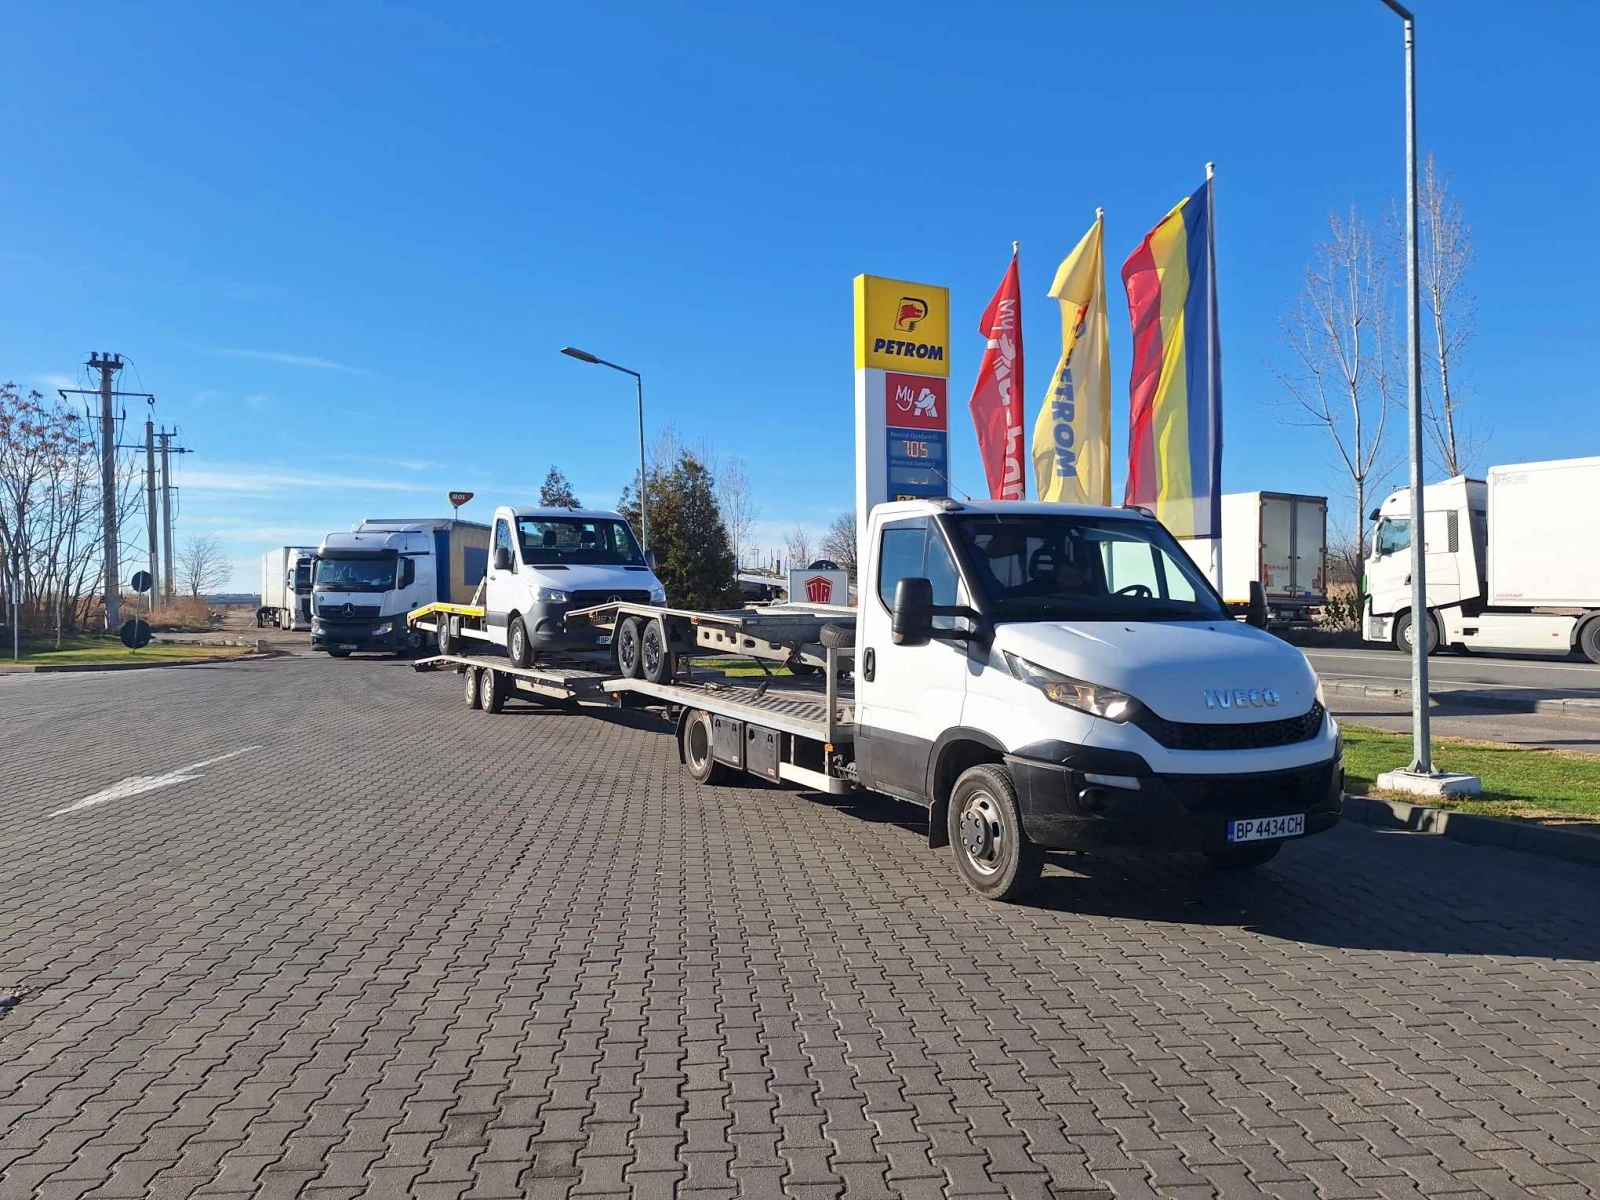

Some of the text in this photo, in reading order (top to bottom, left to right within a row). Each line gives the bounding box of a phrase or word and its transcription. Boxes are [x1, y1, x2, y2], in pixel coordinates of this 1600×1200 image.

[874, 338, 944, 361] PETROM
[896, 385, 914, 411] My
[1052, 366, 1077, 478] ETROM
[1204, 688, 1280, 709] IVECO
[1256, 818, 1285, 837] 4434
